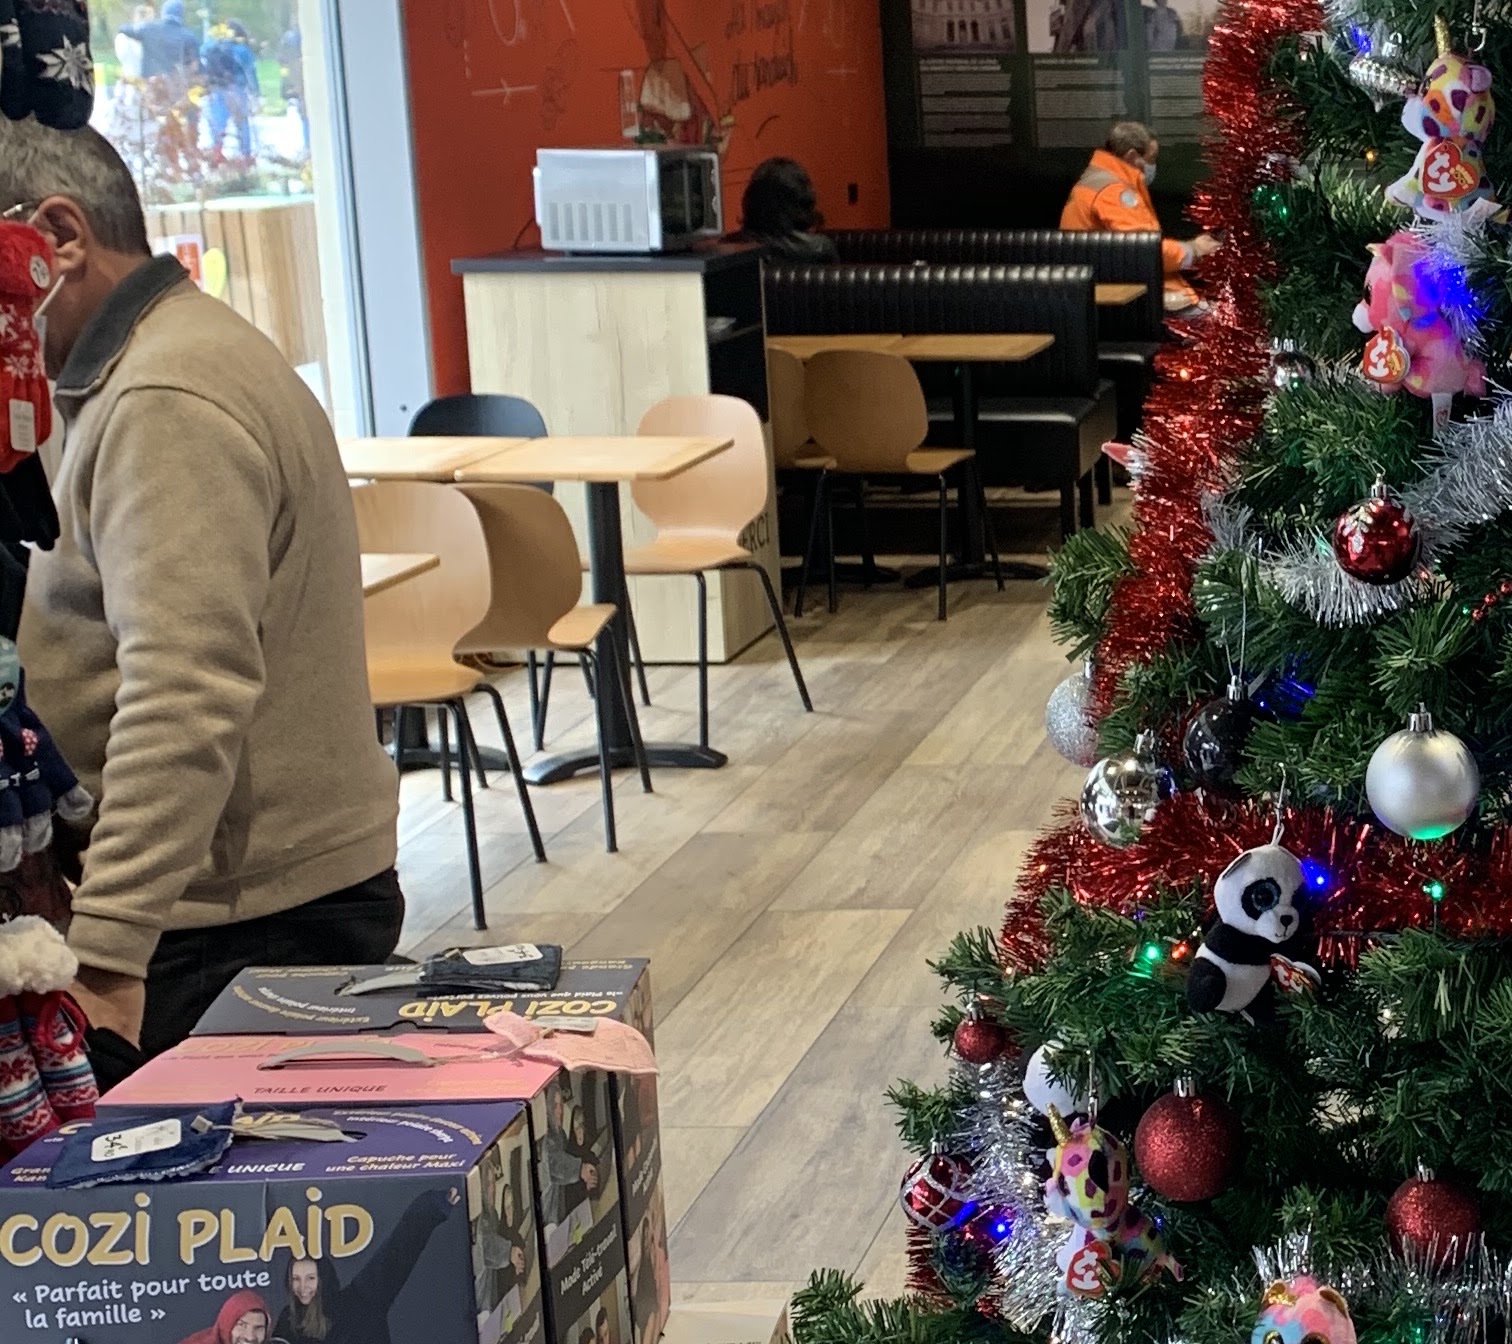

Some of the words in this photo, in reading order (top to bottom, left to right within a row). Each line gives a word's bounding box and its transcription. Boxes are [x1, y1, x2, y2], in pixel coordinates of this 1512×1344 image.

[228, 1163, 306, 1175] UNIQUE
[36, 1280, 122, 1306] Parfait
[131, 1278, 190, 1300] pour
[198, 1269, 271, 1293] toute
[24, 1308, 48, 1329] la
[56, 1304, 142, 1329] famille
